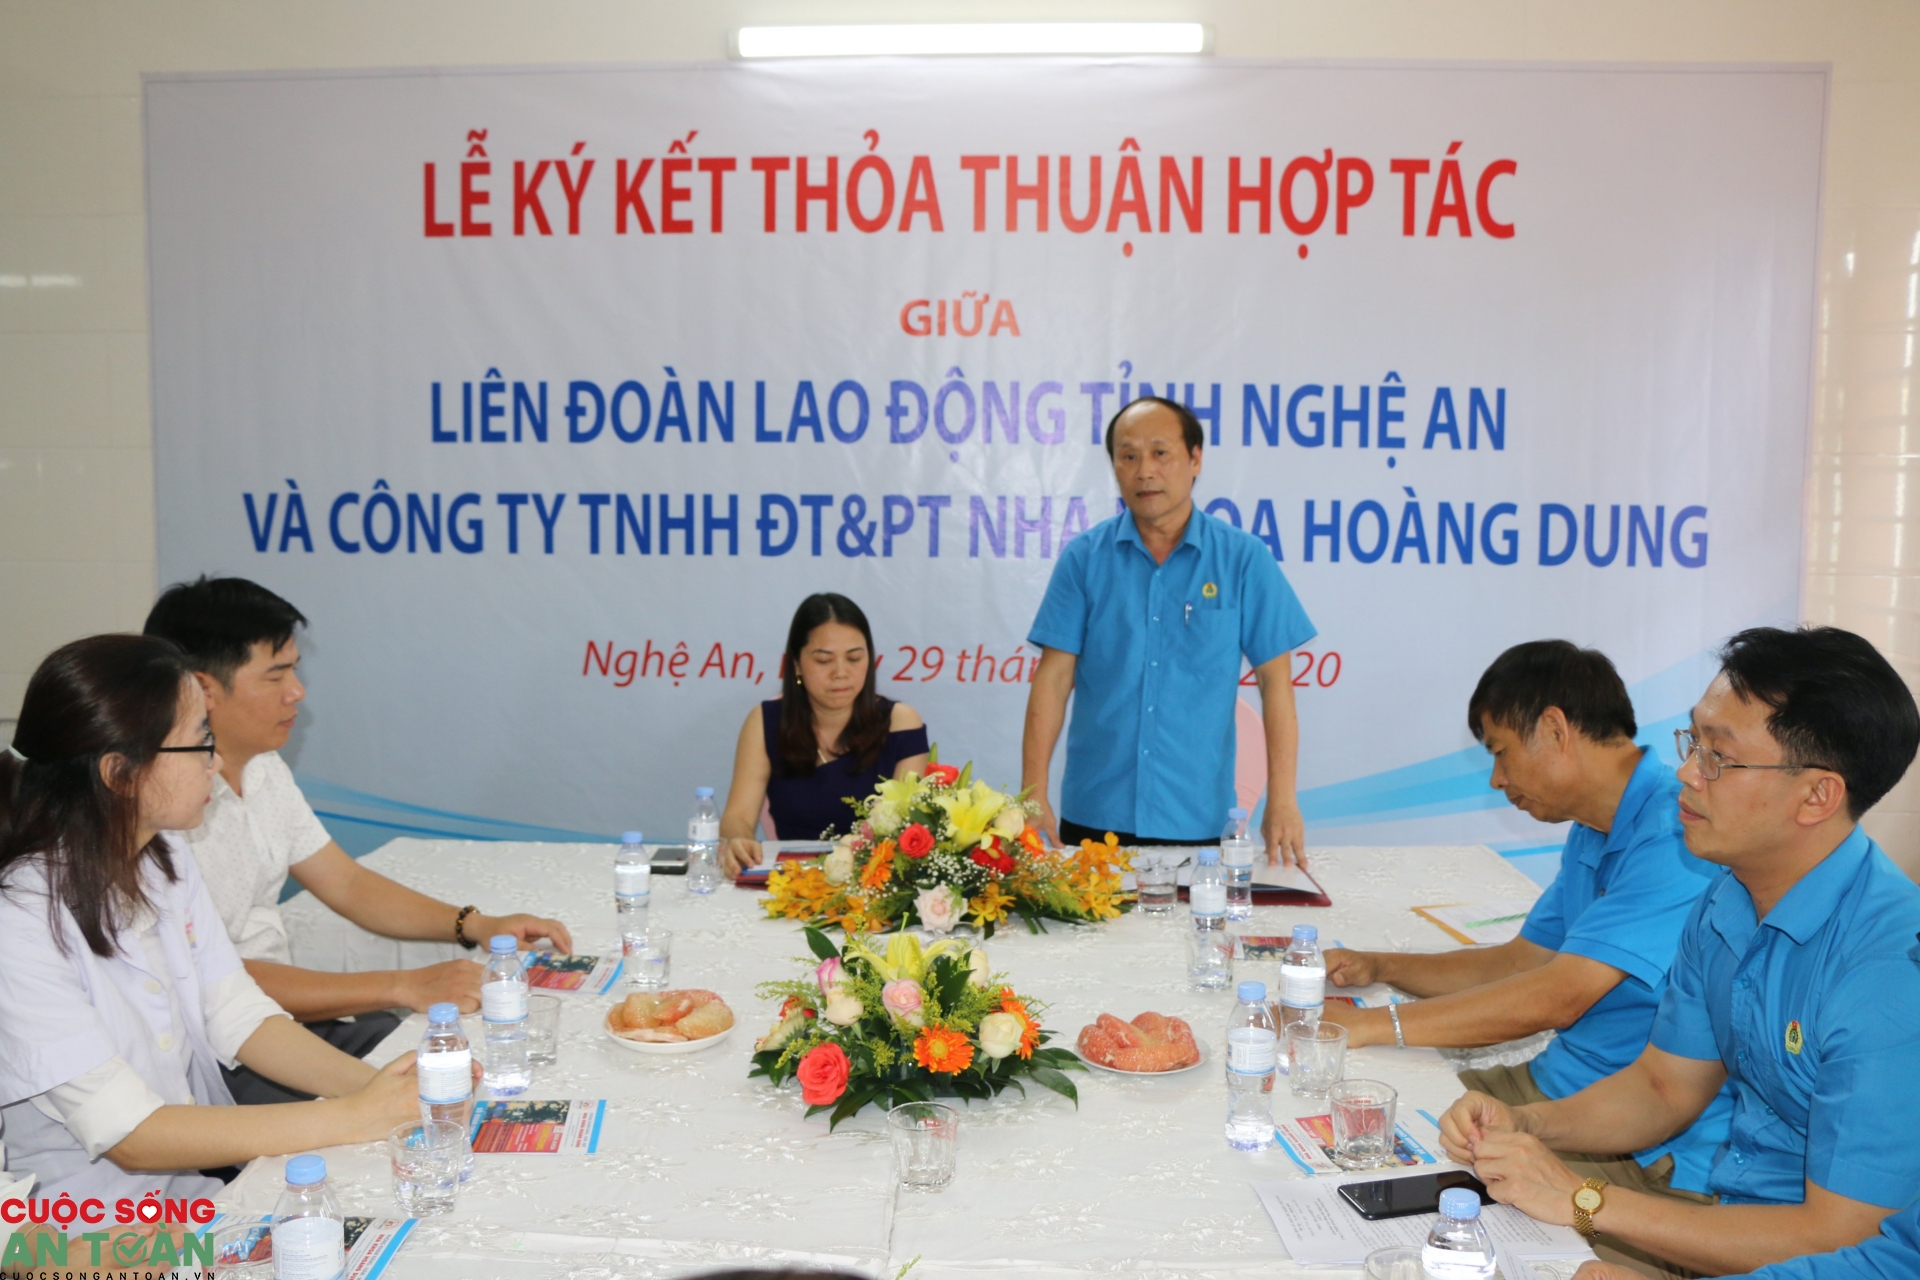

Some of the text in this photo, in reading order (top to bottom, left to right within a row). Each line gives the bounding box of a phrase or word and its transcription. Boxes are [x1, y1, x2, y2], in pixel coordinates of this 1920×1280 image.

[423, 127, 1519, 260] LỄ KÝ KẾT THỎA THUẬN HỢP TÁC
[898, 289, 1021, 338] GIỮA
[431, 367, 548, 443] LIÊN
[564, 366, 735, 444] ĐOÀN
[755, 379, 870, 444] LAO
[886, 366, 1066, 462] ĐỘNG
[1242, 370, 1407, 469] NGHỆ
[1423, 386, 1506, 451] AN
[243, 478, 314, 553] VÀ
[329, 478, 484, 554] CÔNG
[497, 492, 566, 554] TY
[578, 493, 739, 556] TNHH
[755, 493, 952, 558] ĐT&PT
[1303, 485, 1520, 566] HOÀNG
[1538, 502, 1709, 568] DUNG
[583, 640, 690, 687] Nghệ
[699, 642, 765, 685] An,
[891, 645, 944, 685] 29
